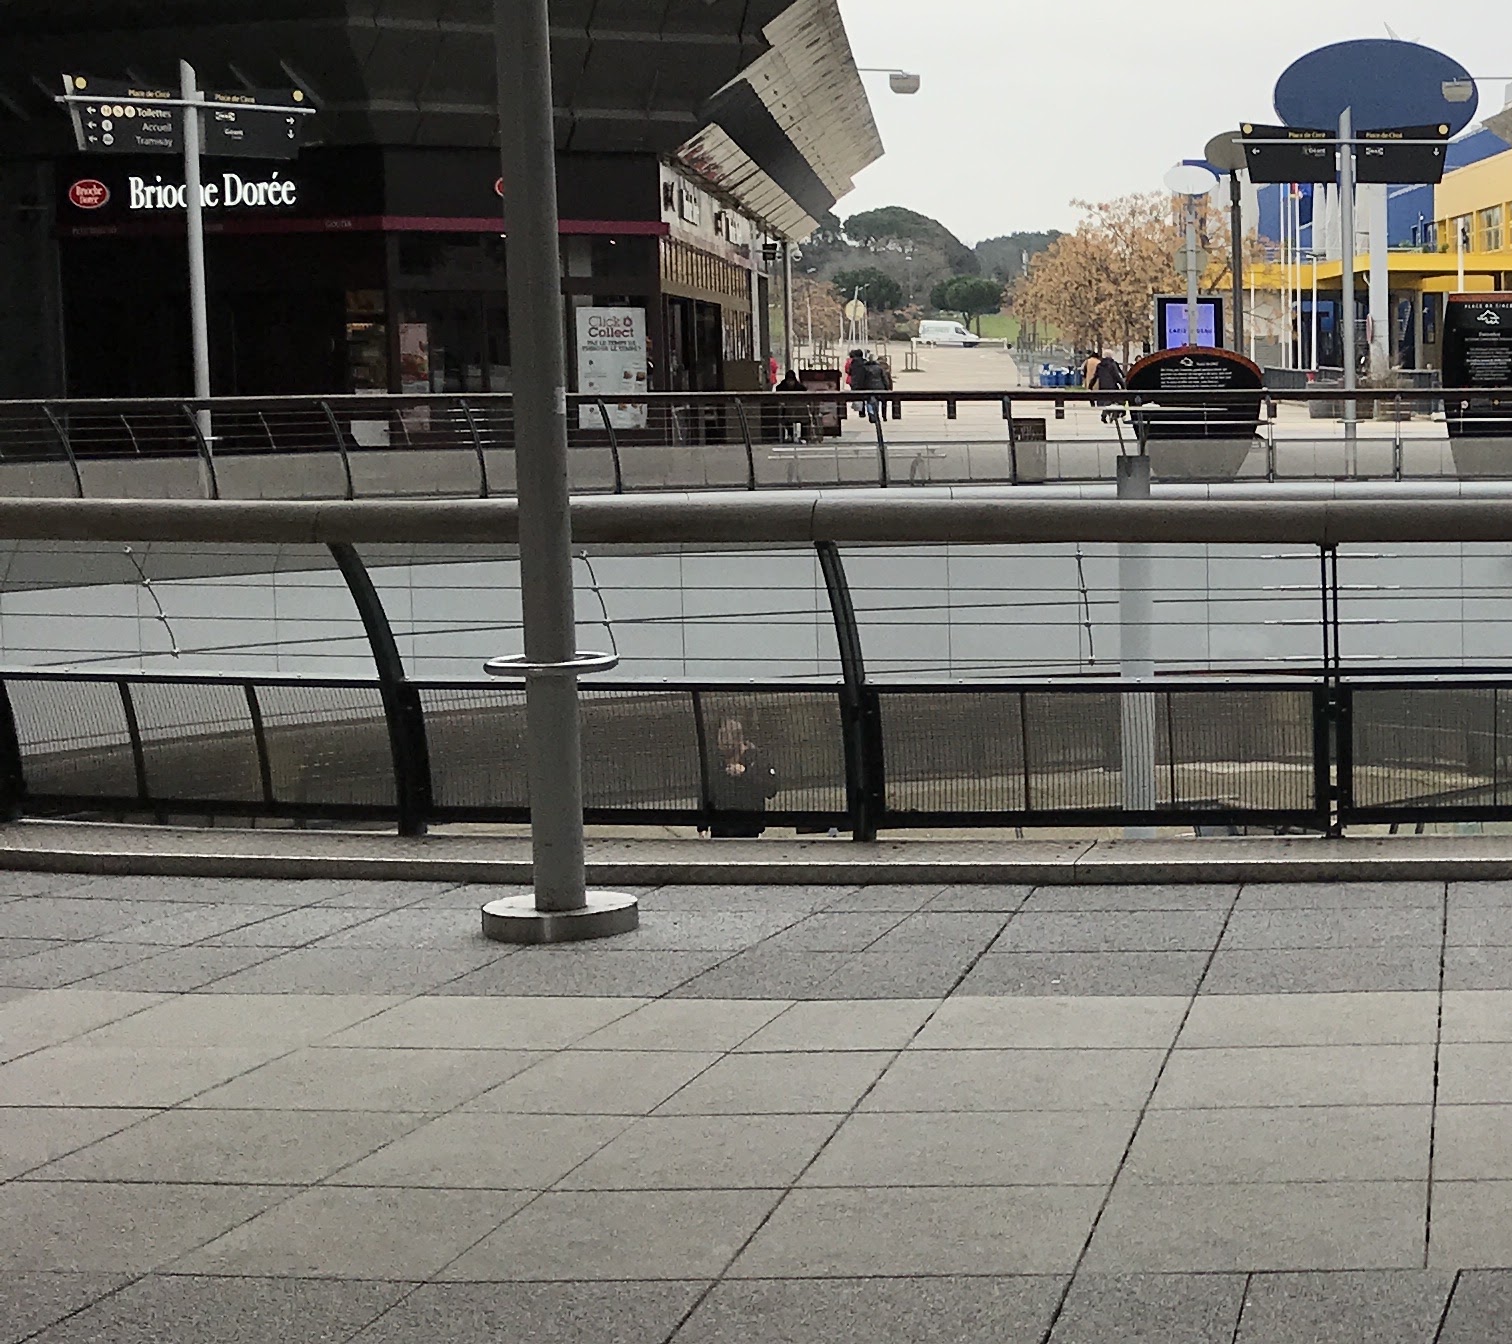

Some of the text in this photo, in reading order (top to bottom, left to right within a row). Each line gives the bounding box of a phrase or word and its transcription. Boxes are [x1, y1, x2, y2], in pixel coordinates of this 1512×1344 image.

[136, 106, 172, 118] Toilettes
[142, 122, 173, 132] Accueil
[135, 135, 173, 148] Tramway
[222, 171, 297, 207] Dorée
[588, 316, 621, 328] Click
[588, 327, 634, 338] Collect
